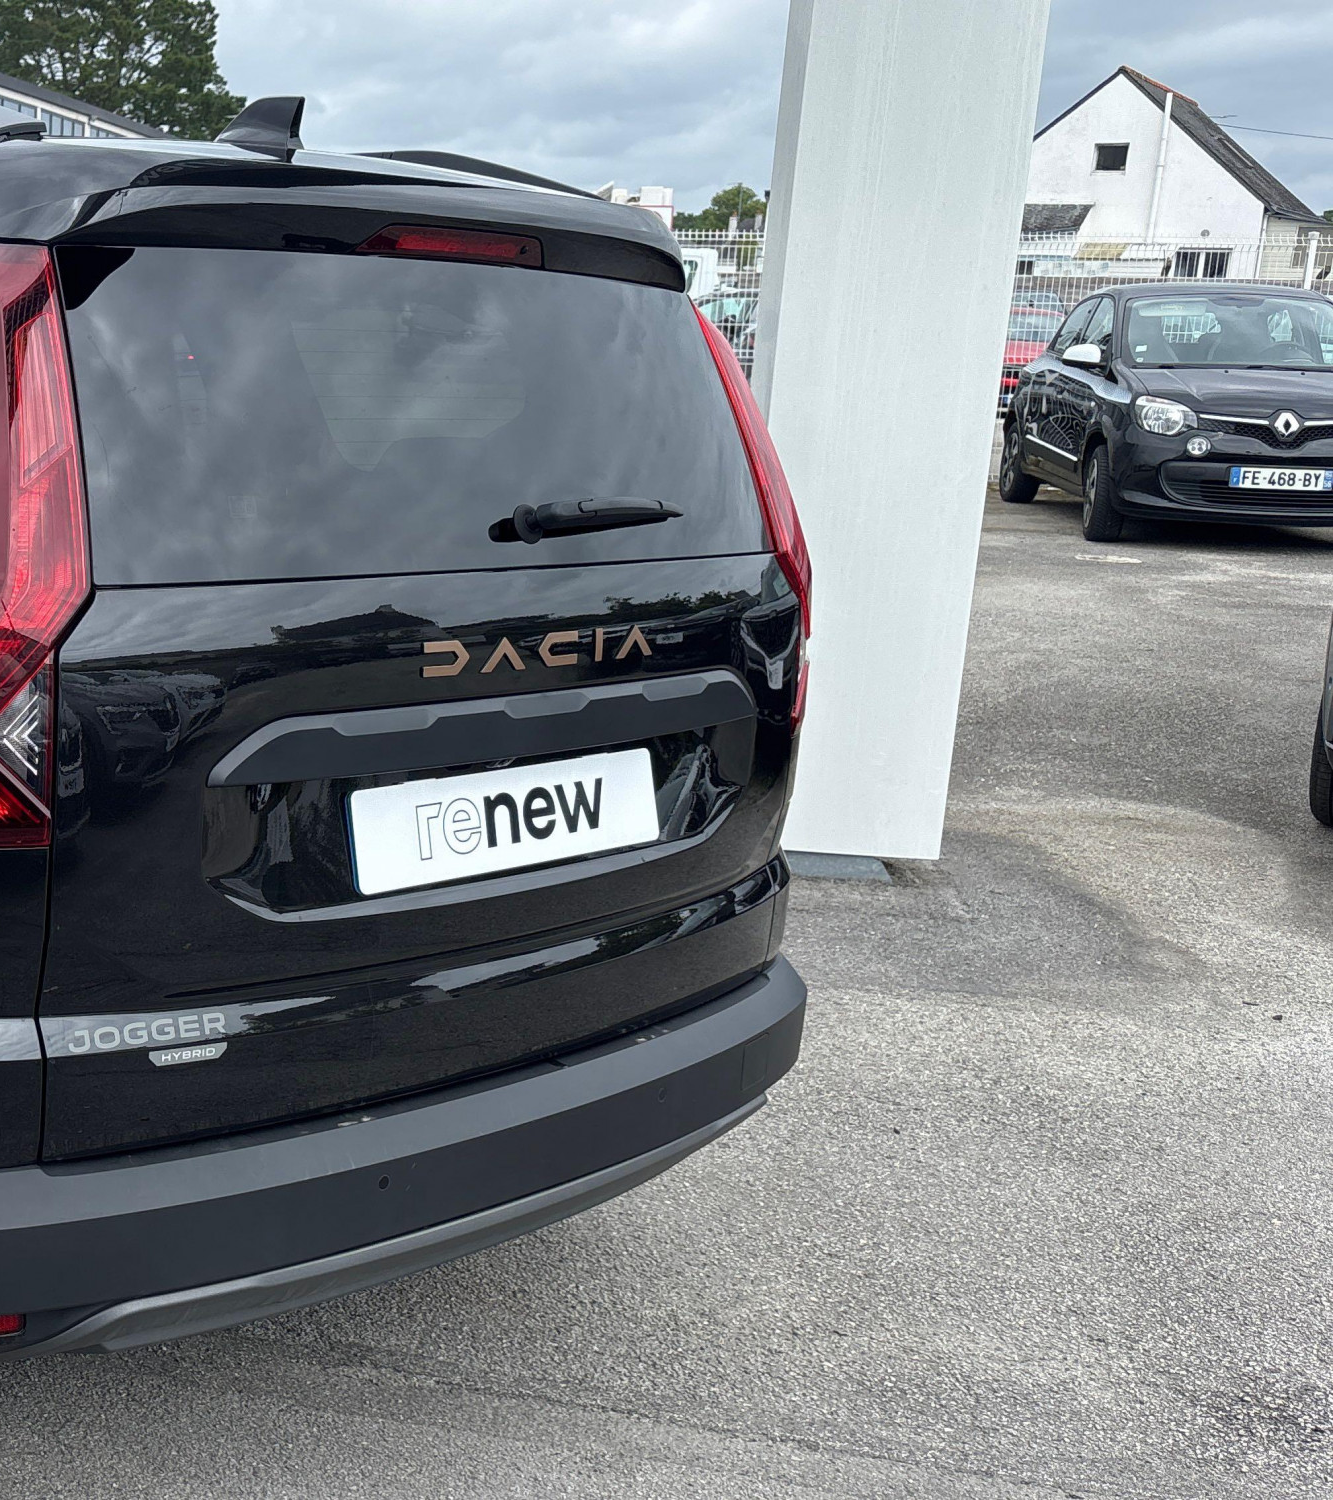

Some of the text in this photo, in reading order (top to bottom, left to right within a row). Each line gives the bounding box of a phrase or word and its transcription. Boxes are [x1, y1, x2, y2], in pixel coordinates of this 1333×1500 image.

[1241, 470, 1322, 488] FE-468-BY
[421, 624, 653, 678] DACIA
[415, 777, 603, 861] renew
[68, 1012, 226, 1053] JOGGER
[161, 1047, 216, 1063] HYBRID
